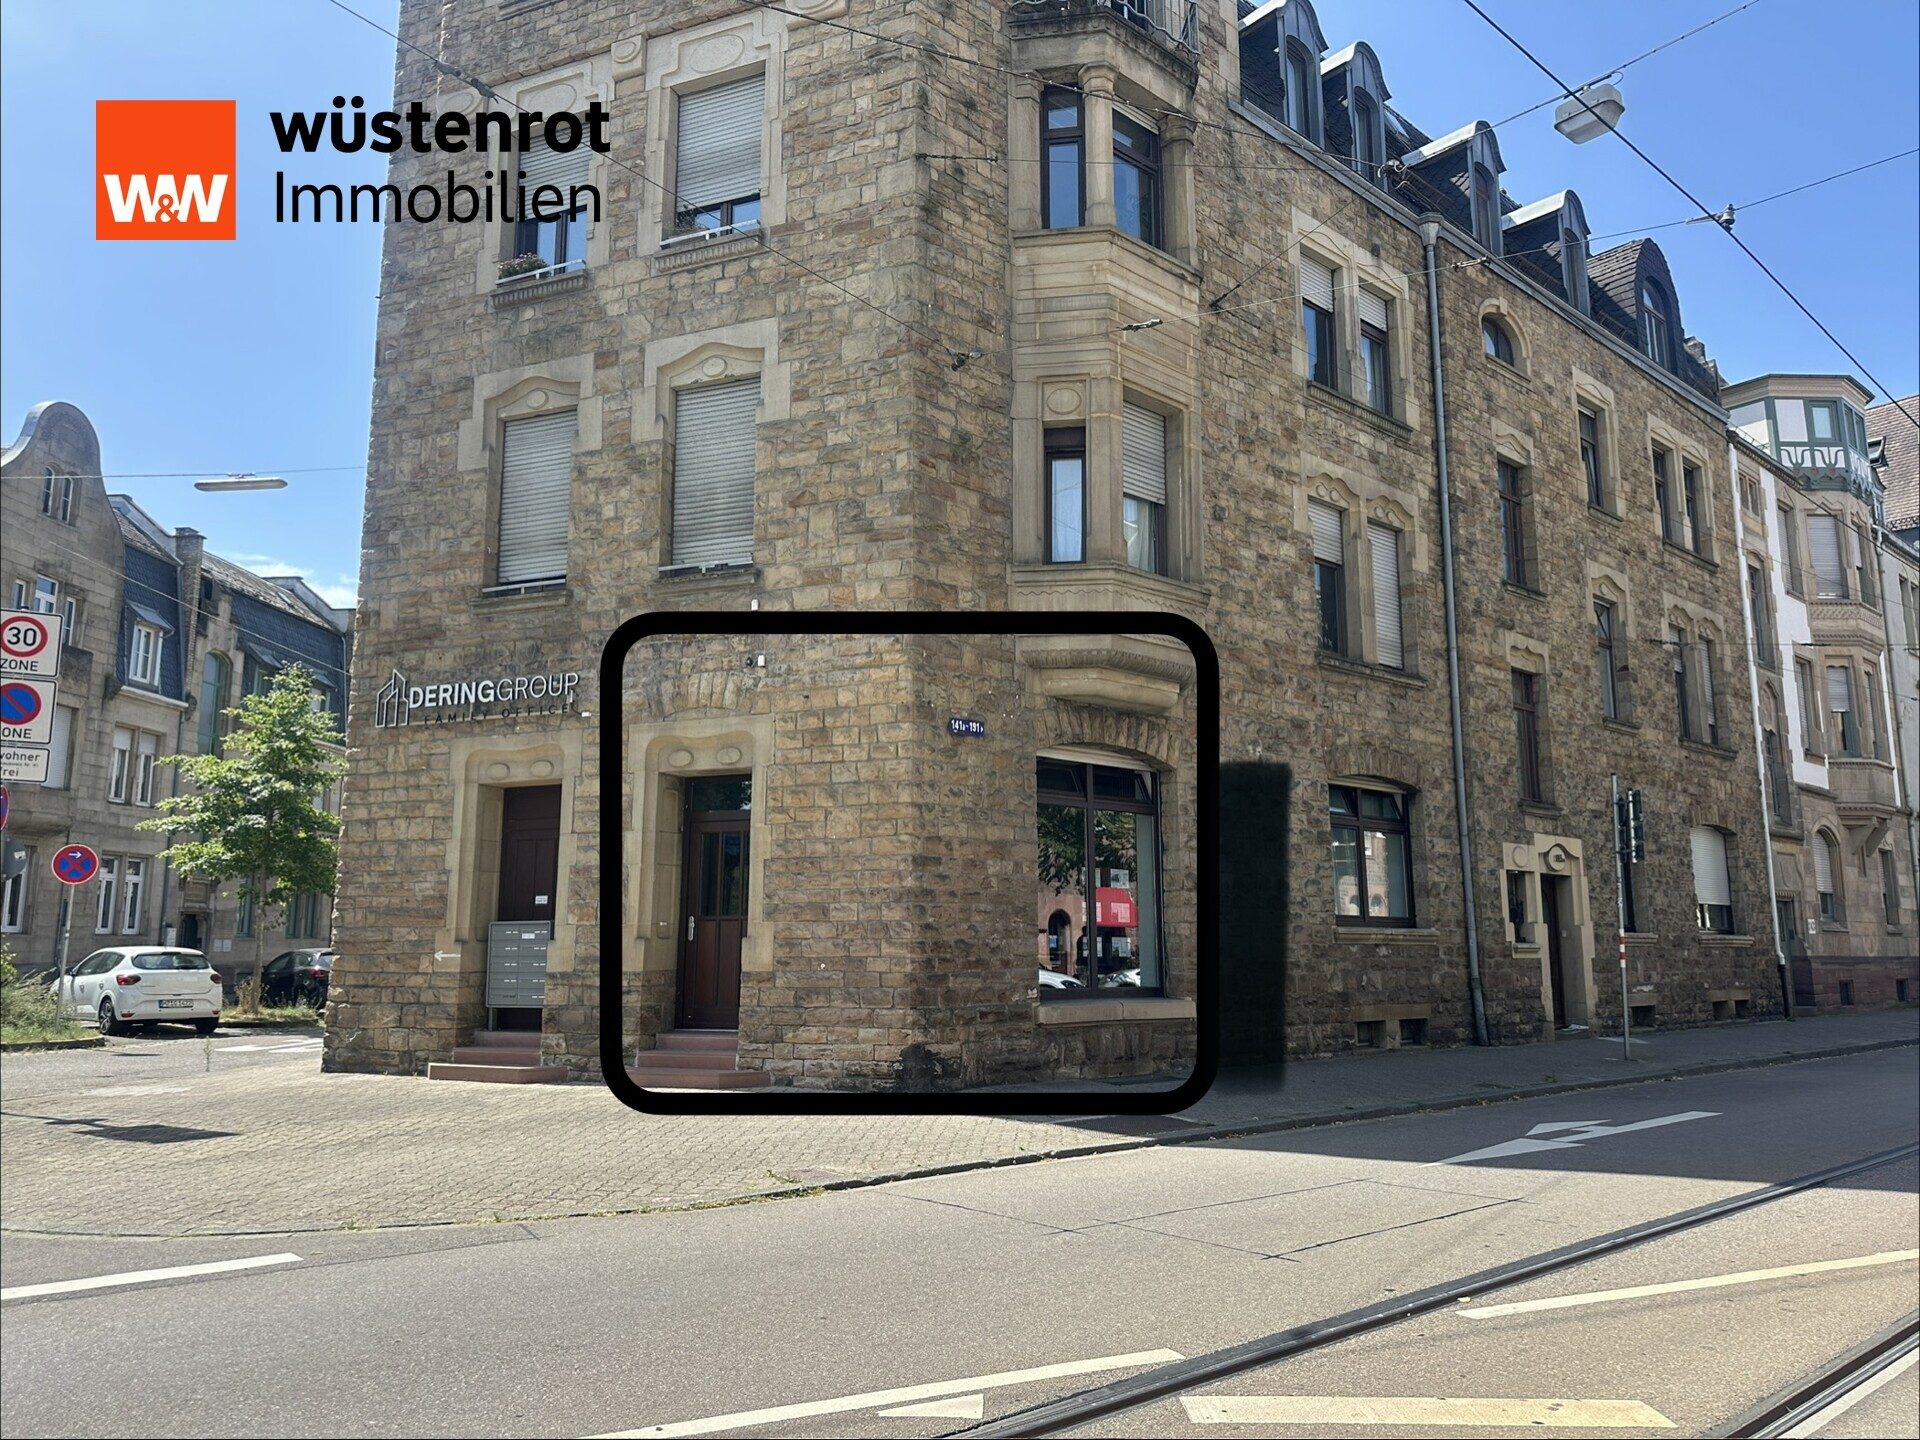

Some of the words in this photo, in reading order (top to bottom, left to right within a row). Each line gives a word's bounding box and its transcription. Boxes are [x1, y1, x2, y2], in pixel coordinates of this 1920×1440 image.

[7, 626, 37, 647] 30
[0, 658, 39, 672] ZONE
[424, 713, 488, 725] FAMILY
[502, 703, 569, 718] OFFICE
[1, 727, 32, 739] ONE
[0, 767, 19, 777] rei
